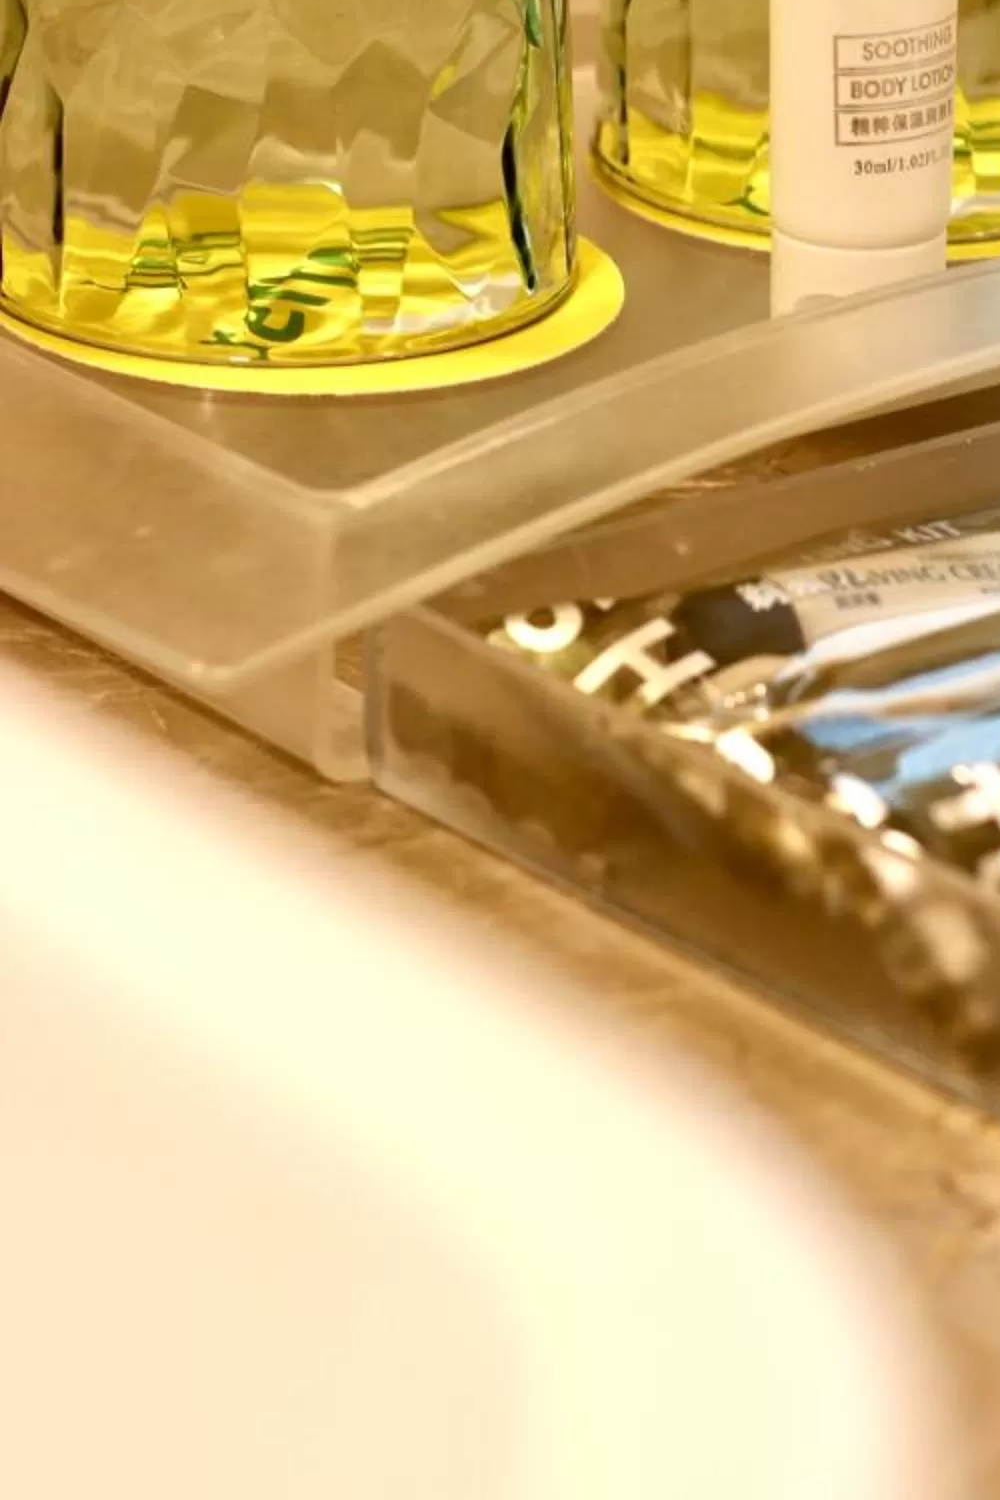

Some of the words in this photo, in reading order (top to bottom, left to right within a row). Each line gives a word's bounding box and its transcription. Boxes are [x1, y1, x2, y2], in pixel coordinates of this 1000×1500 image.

[862, 24, 953, 62] SOOTHING
[850, 76, 908, 101] BODY
[892, 521, 956, 543] KIT
